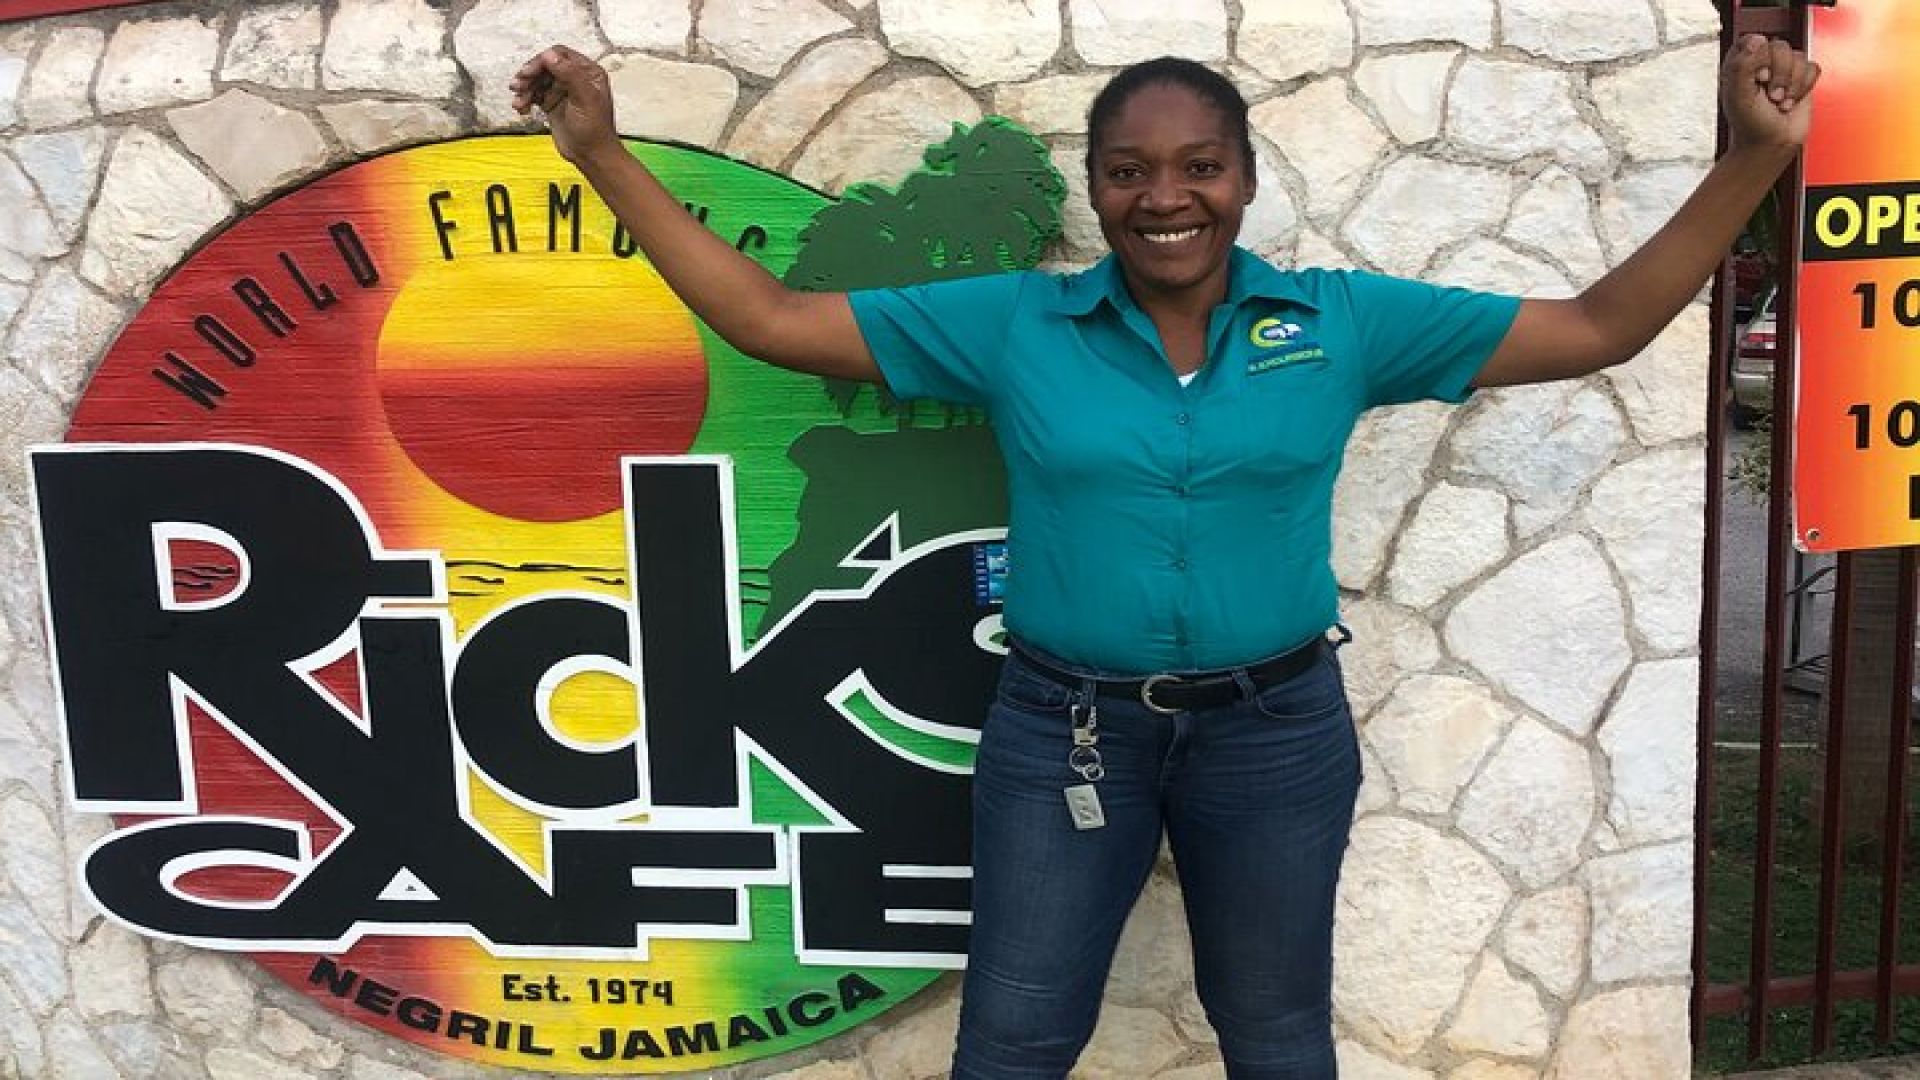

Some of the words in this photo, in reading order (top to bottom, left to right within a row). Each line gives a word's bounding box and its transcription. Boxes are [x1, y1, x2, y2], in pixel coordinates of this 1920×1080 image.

[151, 220, 380, 410] WORLD
[428, 182, 767, 260] FAM
[308, 955, 554, 1056] NEGRIL
[579, 971, 887, 1061] JAMAICA
[502, 973, 571, 1003] Est.
[588, 977, 673, 1006] 1974
